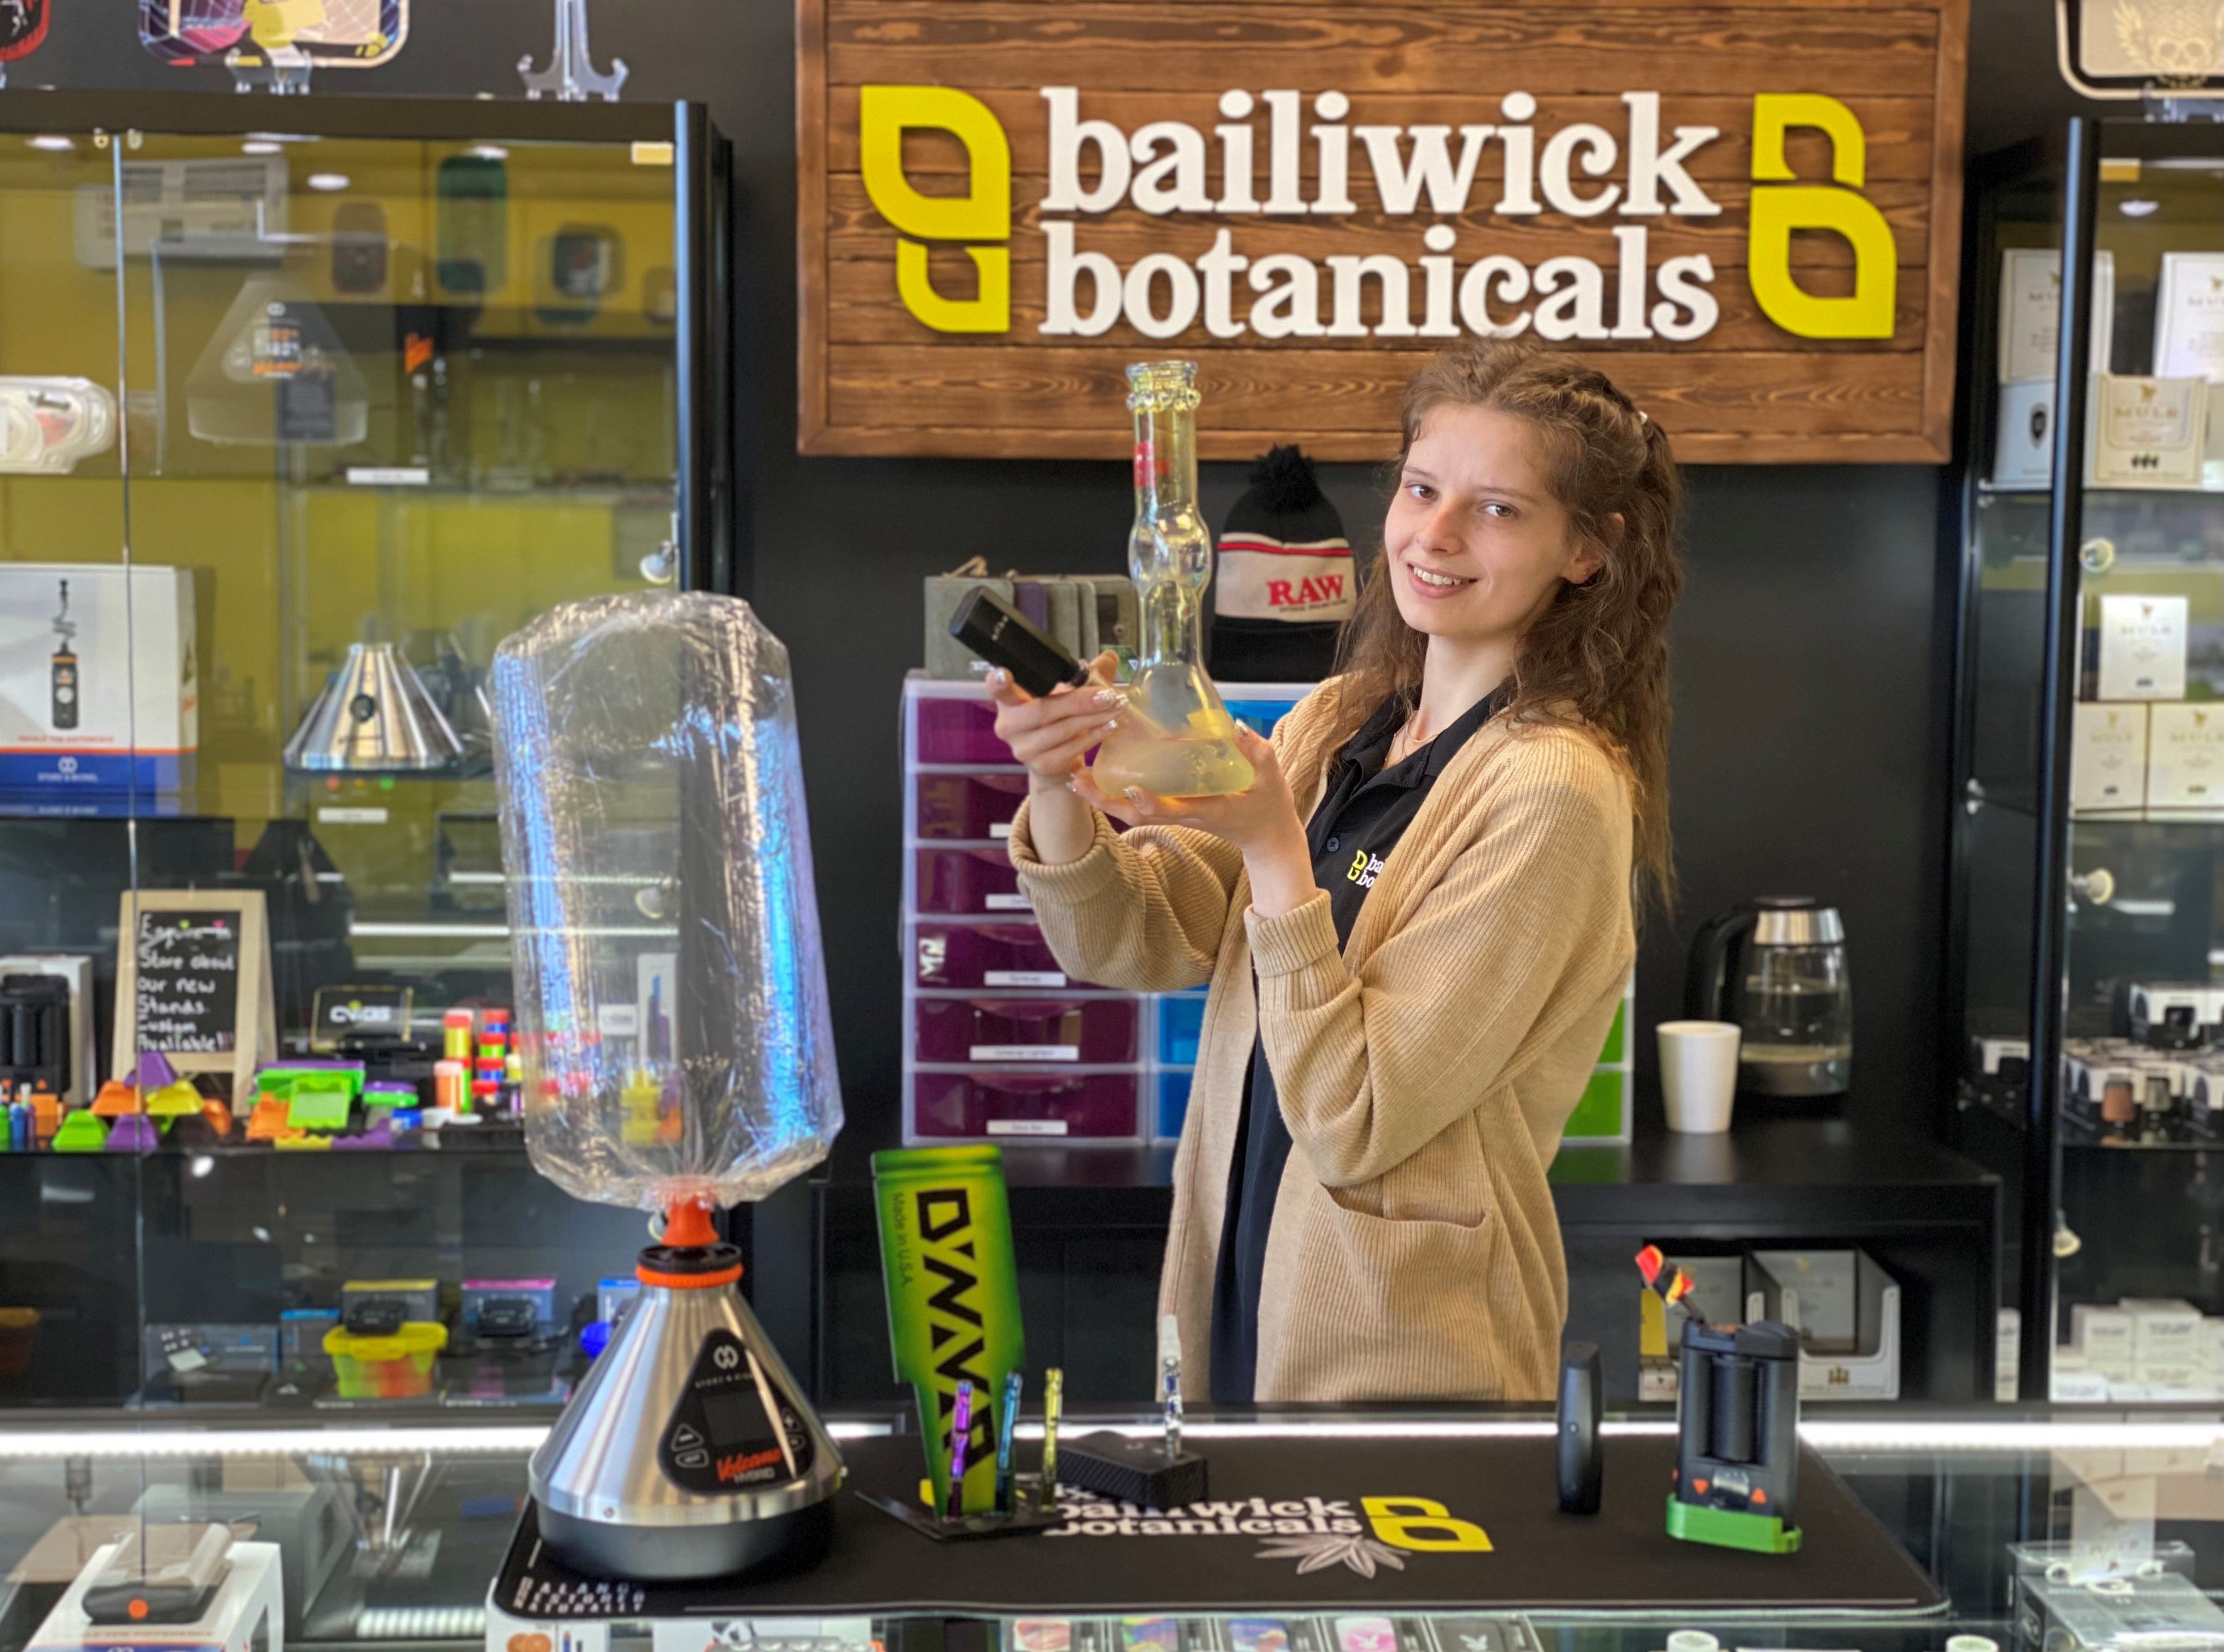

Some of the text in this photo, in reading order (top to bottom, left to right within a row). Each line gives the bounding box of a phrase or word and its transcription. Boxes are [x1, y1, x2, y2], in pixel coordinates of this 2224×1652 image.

[1039, 86, 1721, 217] bailiwick
[1038, 221, 1719, 341] botanicals
[1266, 574, 1344, 606] RAW
[190, 953, 234, 970] about
[137, 976, 215, 993] our new
